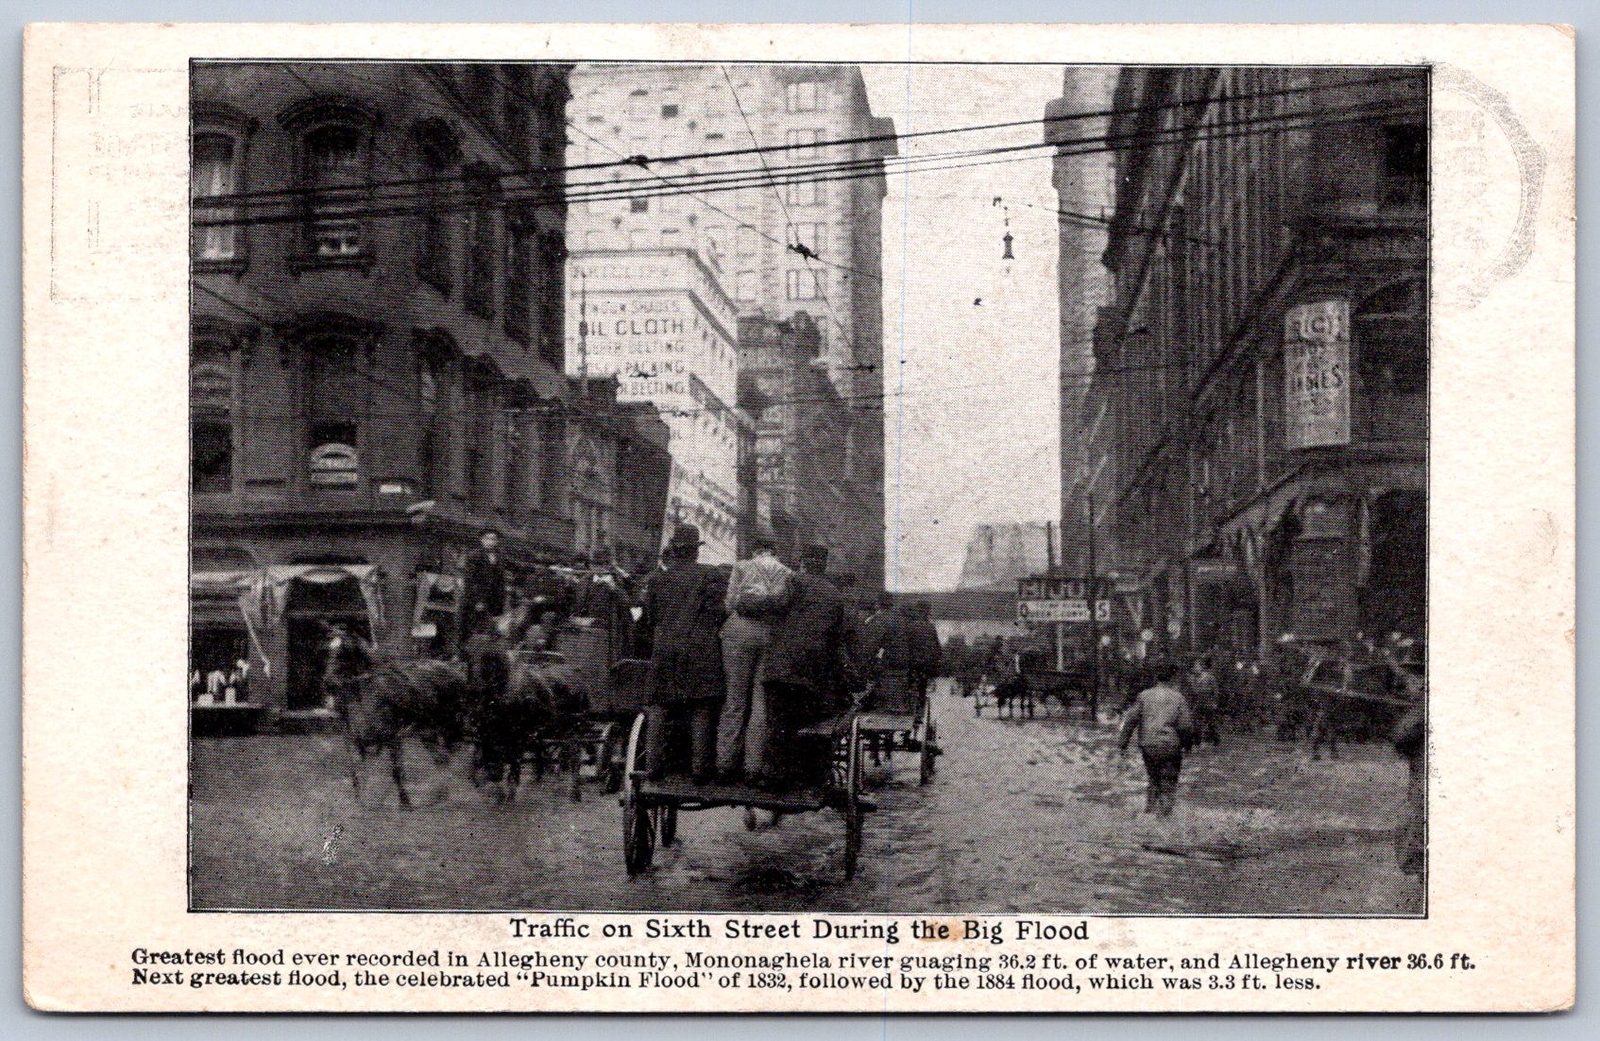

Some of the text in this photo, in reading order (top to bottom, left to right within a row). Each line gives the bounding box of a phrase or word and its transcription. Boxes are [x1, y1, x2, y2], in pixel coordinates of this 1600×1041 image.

[615, 318, 685, 336] CLOTH
[625, 360, 685, 375] PACKING
[631, 380, 685, 396] BELTING
